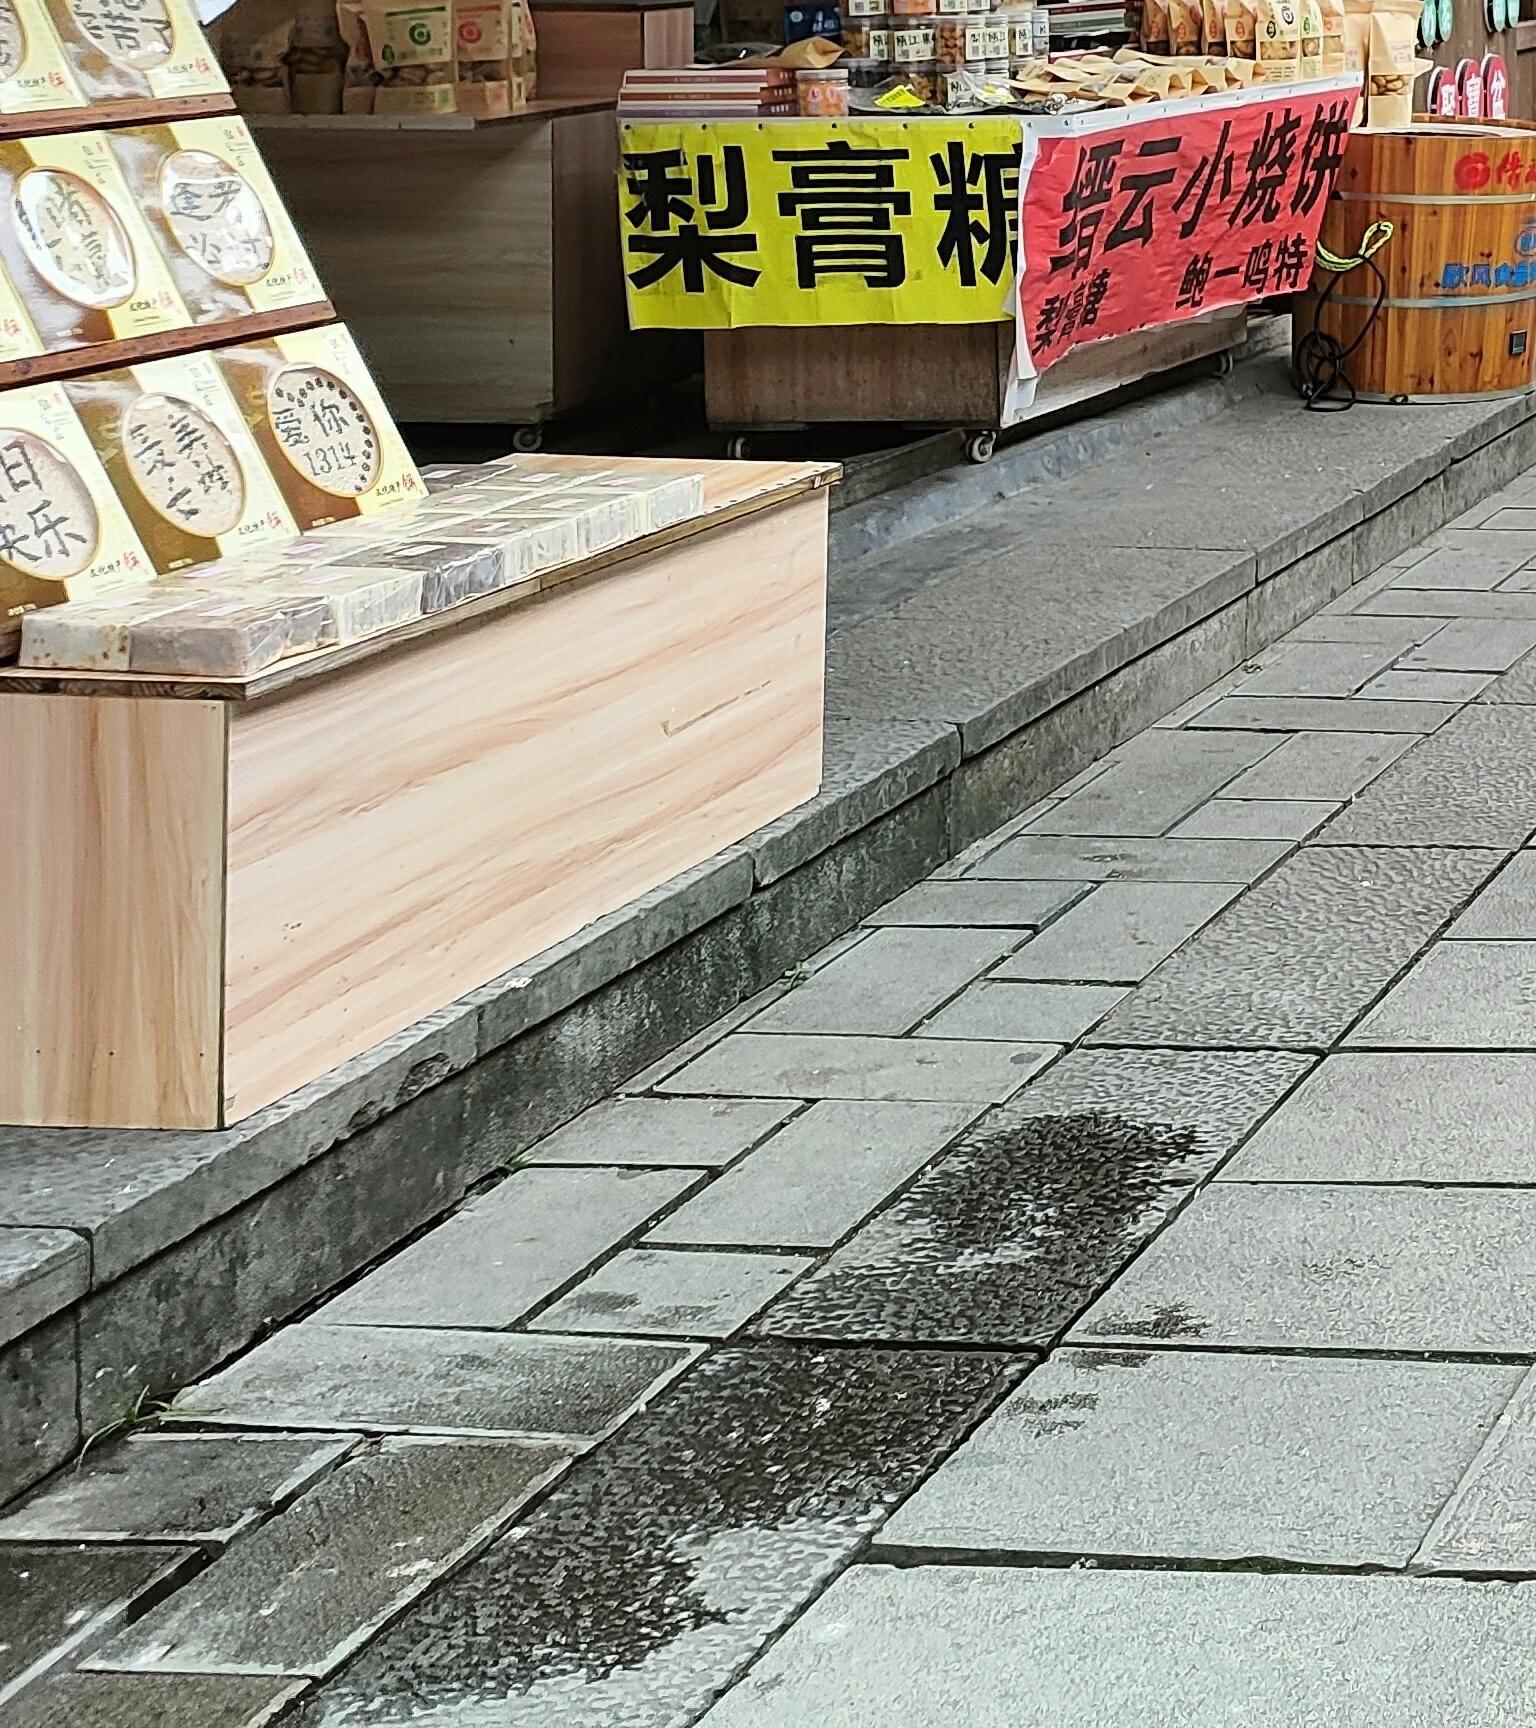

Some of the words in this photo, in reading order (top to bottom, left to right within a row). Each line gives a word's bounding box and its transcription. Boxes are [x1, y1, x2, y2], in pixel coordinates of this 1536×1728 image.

[1049, 97, 1350, 281] 缙云小烧饼
[304, 441, 357, 478] 1314
